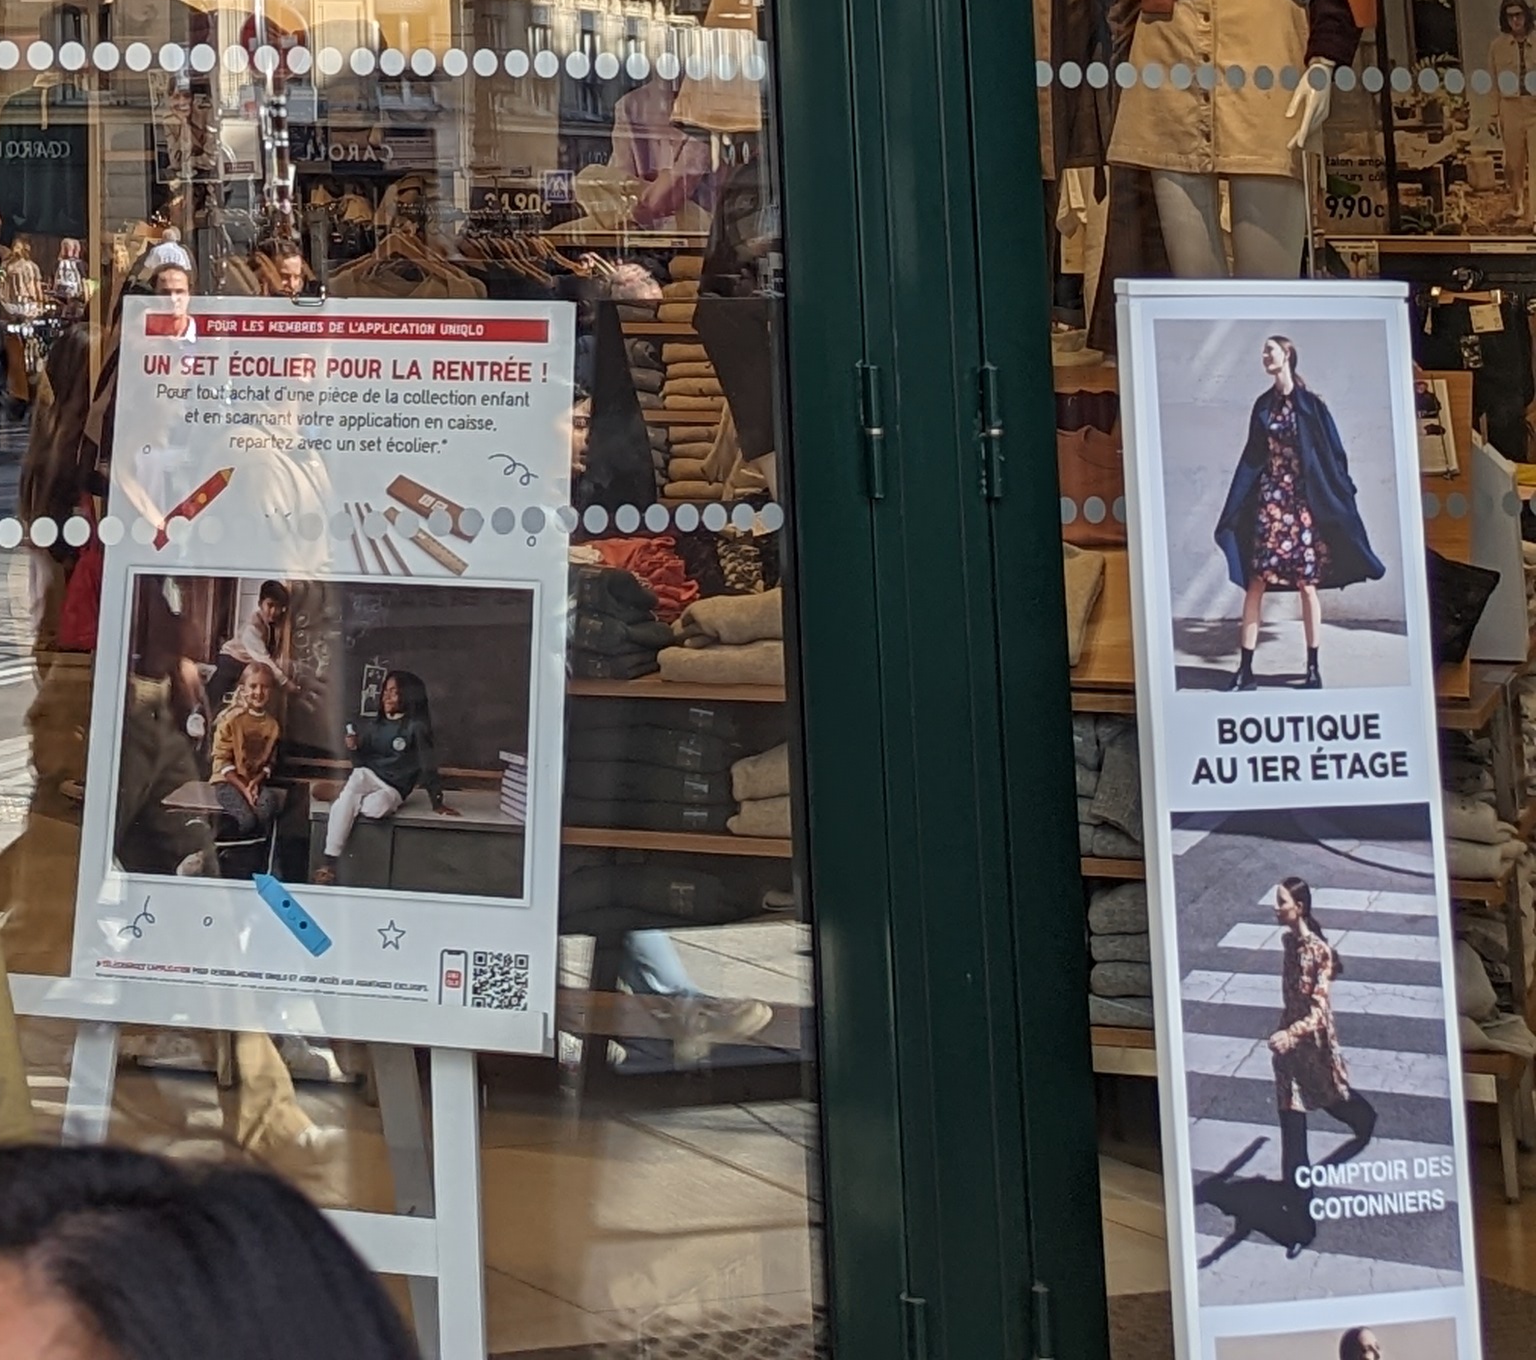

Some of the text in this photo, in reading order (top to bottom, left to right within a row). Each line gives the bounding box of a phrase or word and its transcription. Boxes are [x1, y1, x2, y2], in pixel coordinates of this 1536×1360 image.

[207, 319, 484, 336] POUR LES MEMBRES DE L'APPLICATION UNIQLO
[144, 354, 170, 375] UN
[180, 355, 219, 376] SET
[228, 350, 316, 377] ÉCOLIER
[326, 357, 381, 379] POUR
[392, 358, 422, 380] LA
[432, 355, 532, 382] RENTRÉE
[156, 383, 530, 408] Pour tout achat d'une pièce de la collection enfant
[184, 408, 199, 423] et
[203, 412, 221, 424] en
[225, 410, 292, 425] scannant
[297, 410, 334, 427] votre
[339, 412, 420, 431] application
[424, 416, 443, 429] en
[229, 434, 293, 452] repartez
[297, 438, 332, 451] avec
[337, 438, 355, 451] un
[359, 437, 382, 452] set
[1217, 713, 1382, 745] BOUTIQUE
[1192, 746, 1408, 785] AU 1ER ÉTAGE
[1295, 1154, 1453, 1188] COMPTOIR DES
[1309, 1186, 1446, 1221] COTONNIERS
